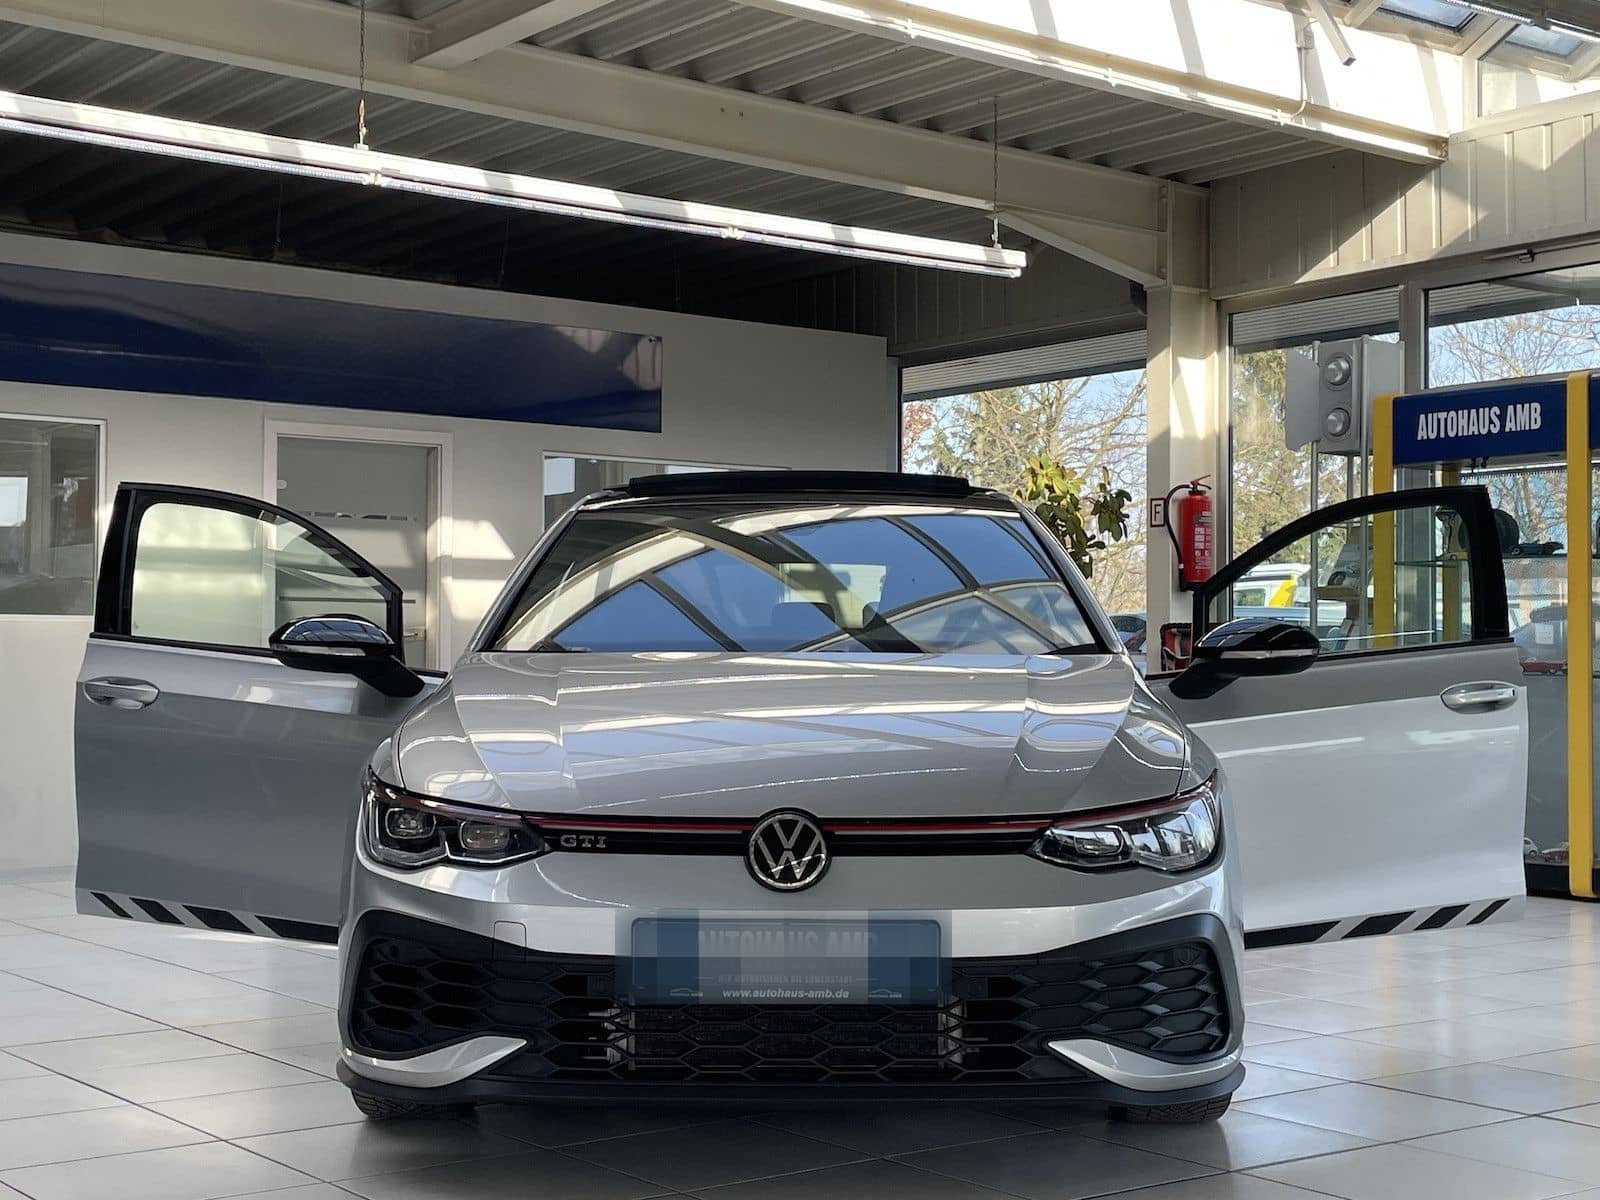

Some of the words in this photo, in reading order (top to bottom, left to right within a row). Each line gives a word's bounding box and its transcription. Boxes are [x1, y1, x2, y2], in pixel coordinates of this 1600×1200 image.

[1417, 406, 1500, 440] AUTOHAUS
[1505, 402, 1541, 432] AMB
[1154, 504, 1162, 522] F
[560, 834, 606, 848] GTI
[722, 988, 850, 999] www.autohaus-amb.de
